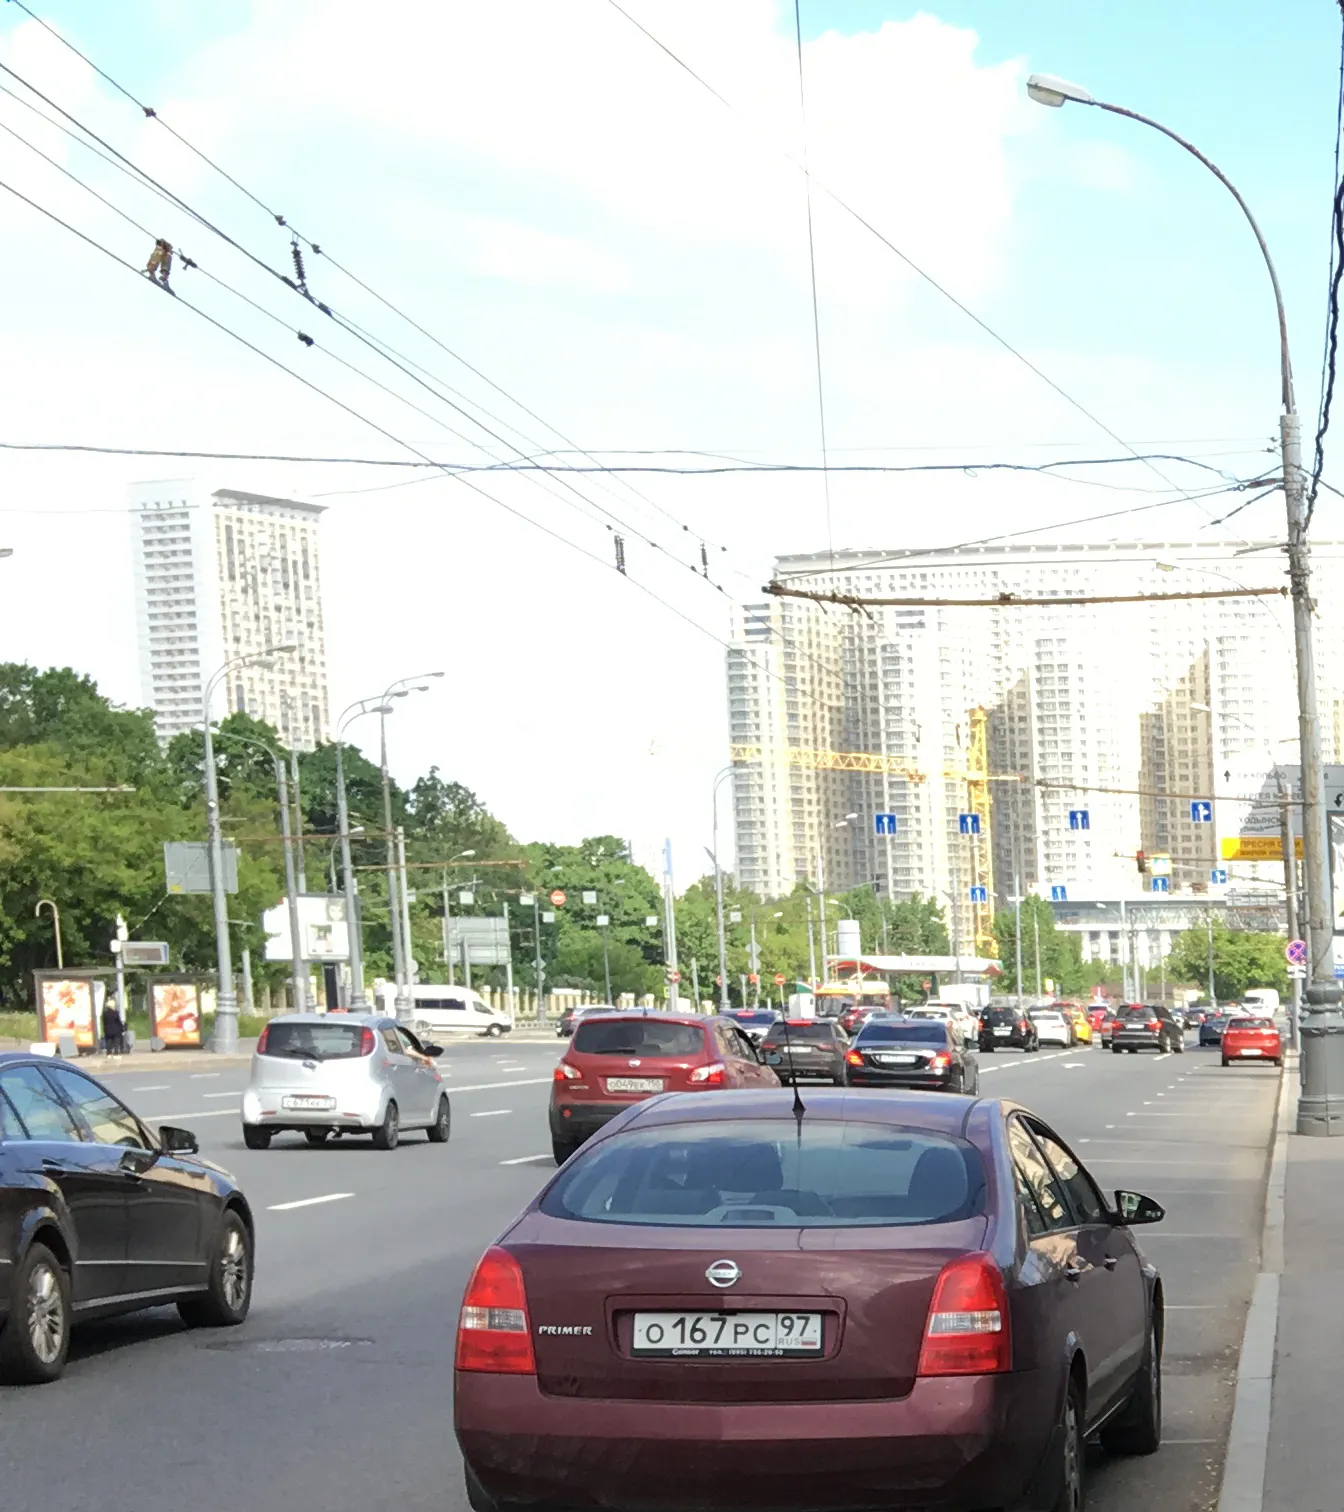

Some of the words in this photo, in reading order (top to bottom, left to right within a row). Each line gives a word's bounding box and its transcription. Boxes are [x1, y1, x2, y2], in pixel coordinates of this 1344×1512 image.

[538, 1325, 593, 1336] PRIMER
[780, 1315, 810, 1337] 97
[778, 1337, 800, 1346] RUS
